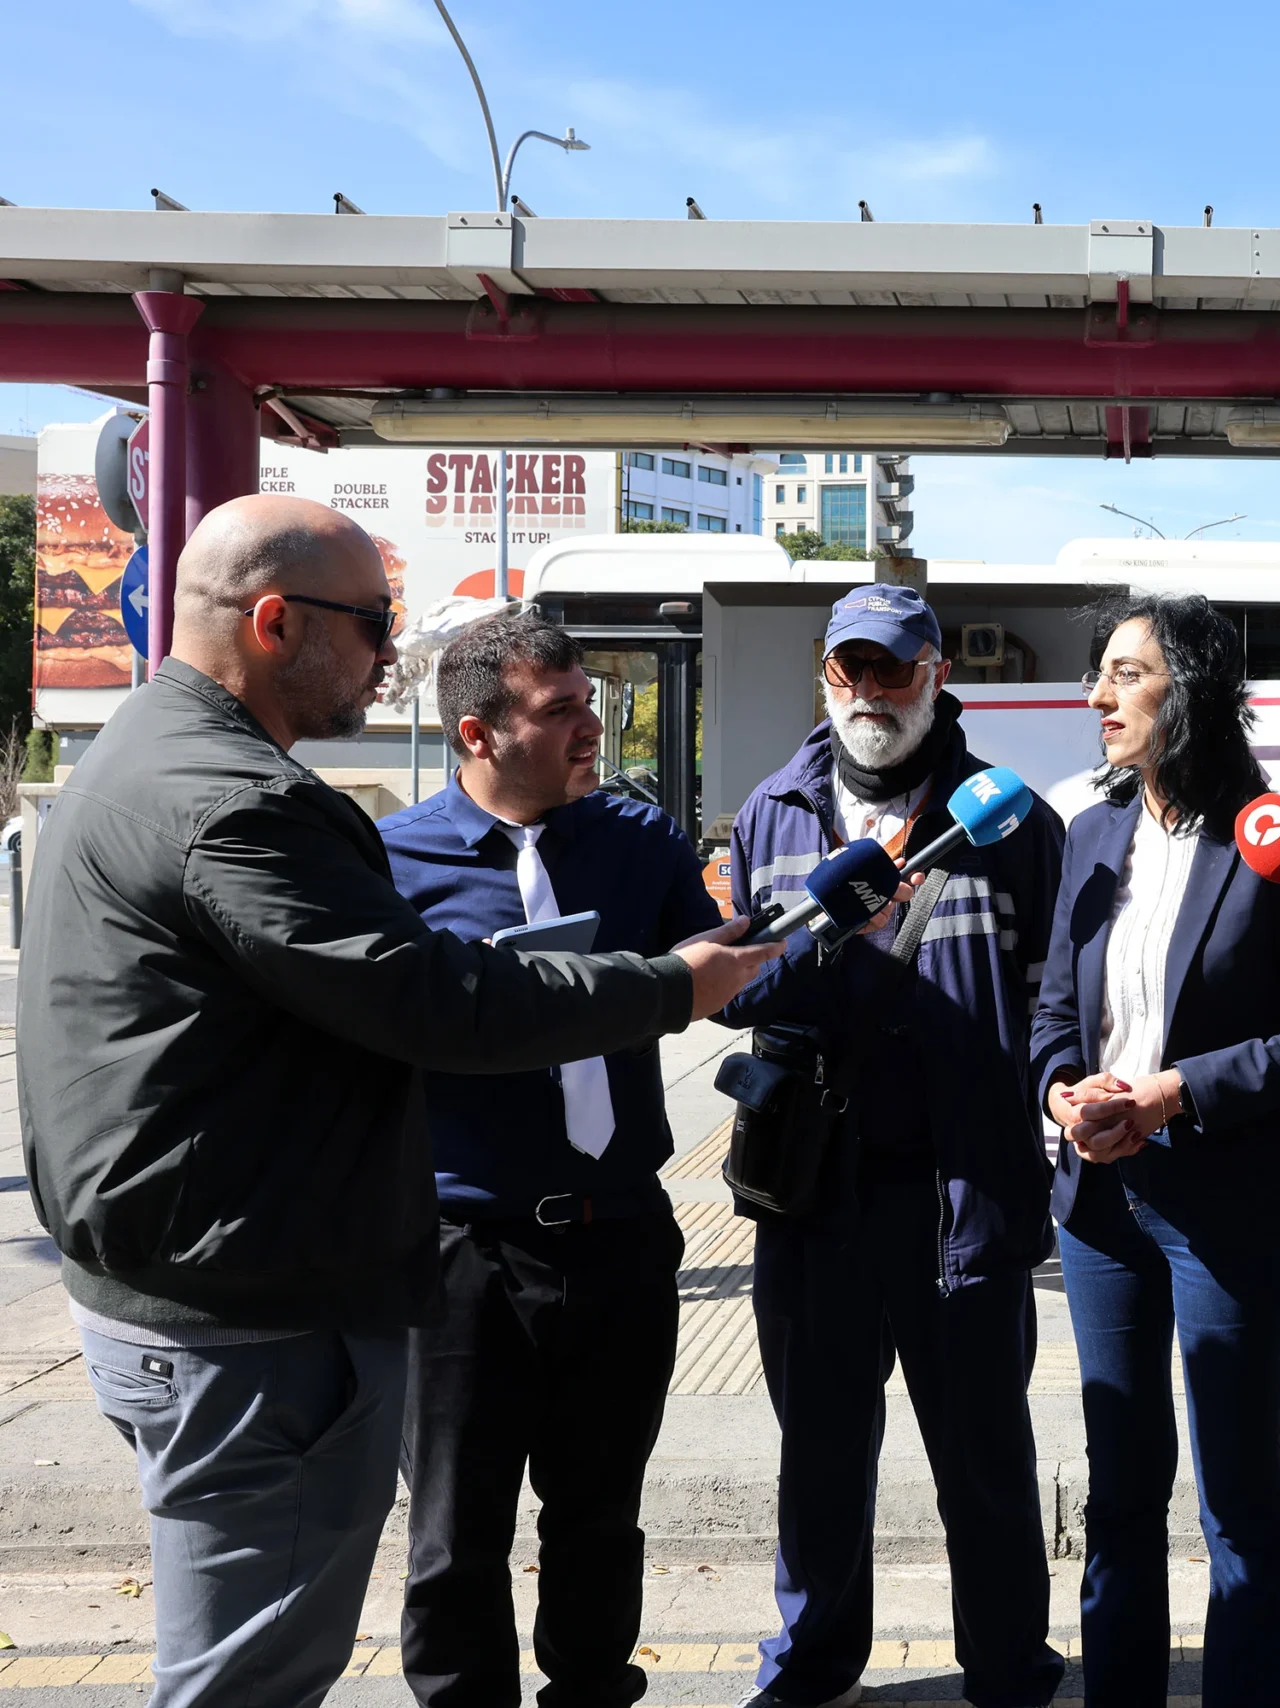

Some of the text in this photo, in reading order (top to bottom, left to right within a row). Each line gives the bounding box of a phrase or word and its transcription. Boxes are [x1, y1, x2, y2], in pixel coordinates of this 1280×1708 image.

[260, 467, 288, 478] IPLE
[426, 453, 586, 494] STACKER
[259, 481, 295, 492] CKER
[334, 484, 387, 495] DOUBLE
[330, 497, 389, 509] STACKER
[465, 532, 550, 544] STAC IT UP!
